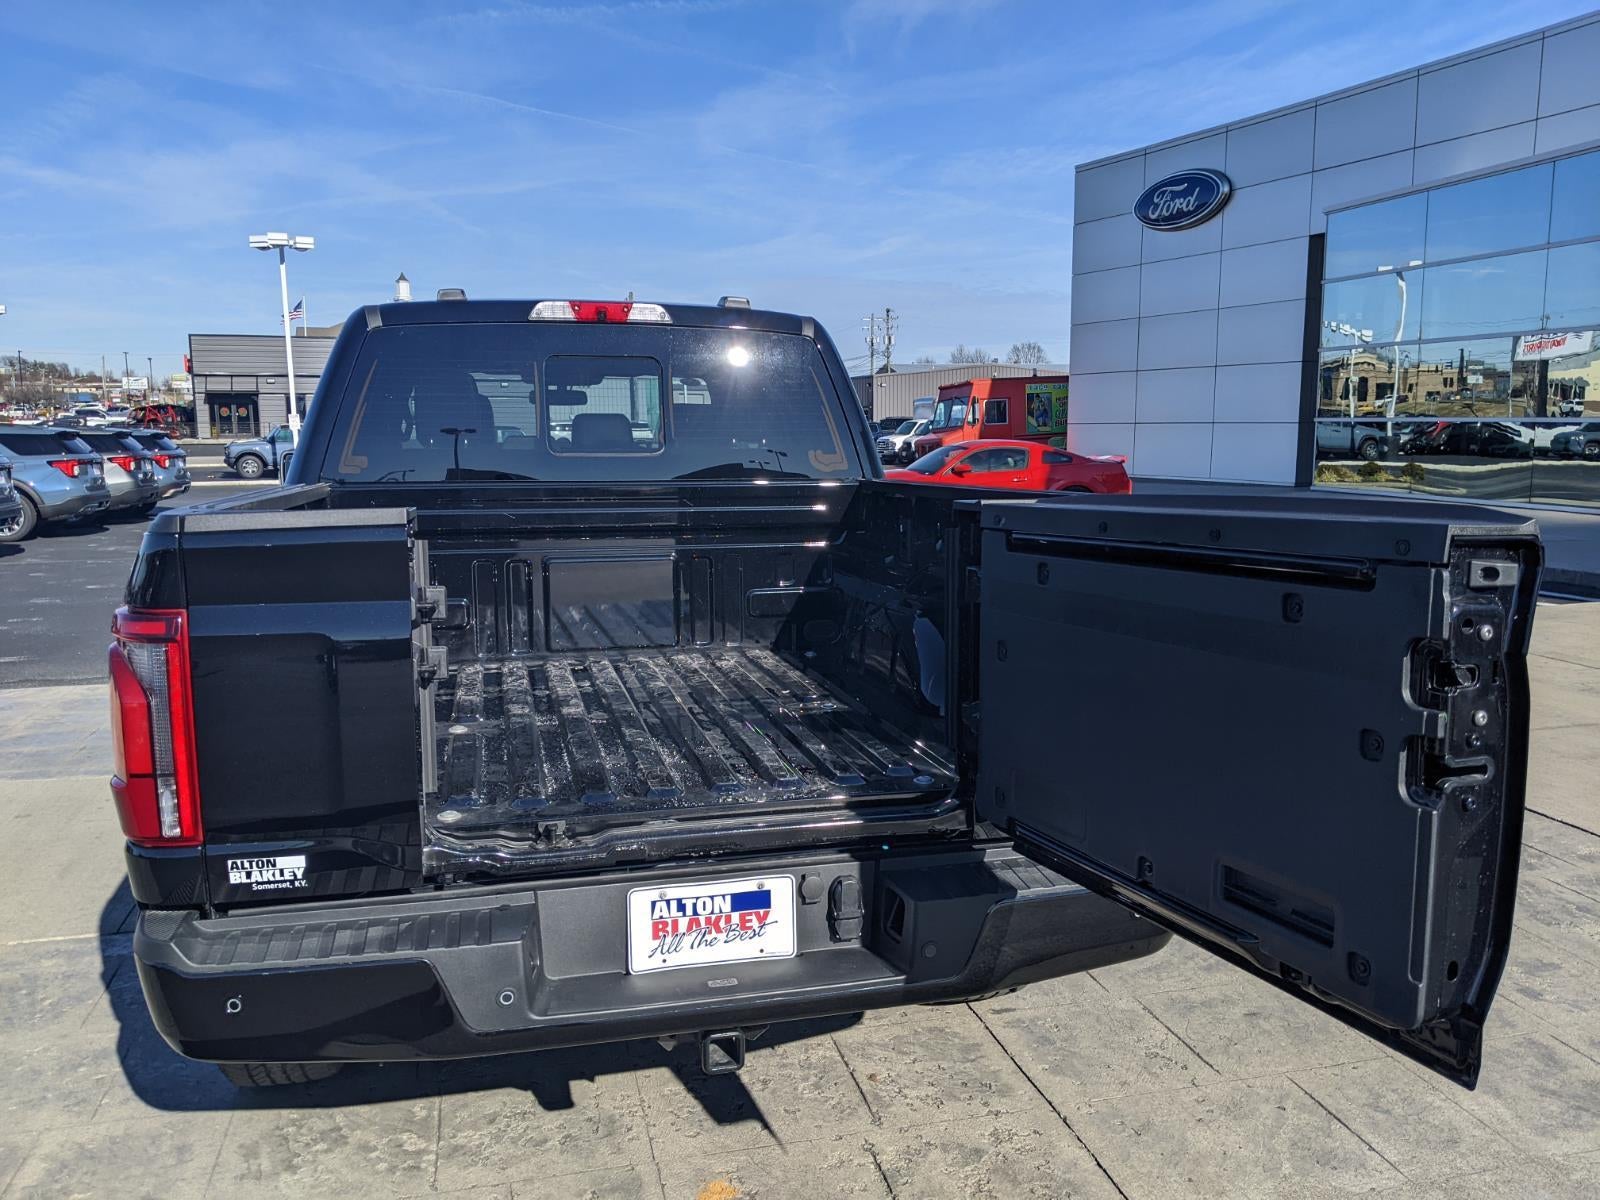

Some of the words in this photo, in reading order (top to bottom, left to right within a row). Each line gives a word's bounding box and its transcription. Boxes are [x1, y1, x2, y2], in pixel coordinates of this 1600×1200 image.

[1148, 183, 1200, 219] Ford
[229, 867, 305, 884] BLAKLEY
[230, 858, 277, 871] ALTON
[252, 881, 293, 891] Somerset,
[652, 895, 732, 919] ALTON
[651, 910, 771, 941] BLAKLEY
[648, 932, 684, 958] All
[684, 926, 720, 950] The
[722, 920, 778, 944] Best
